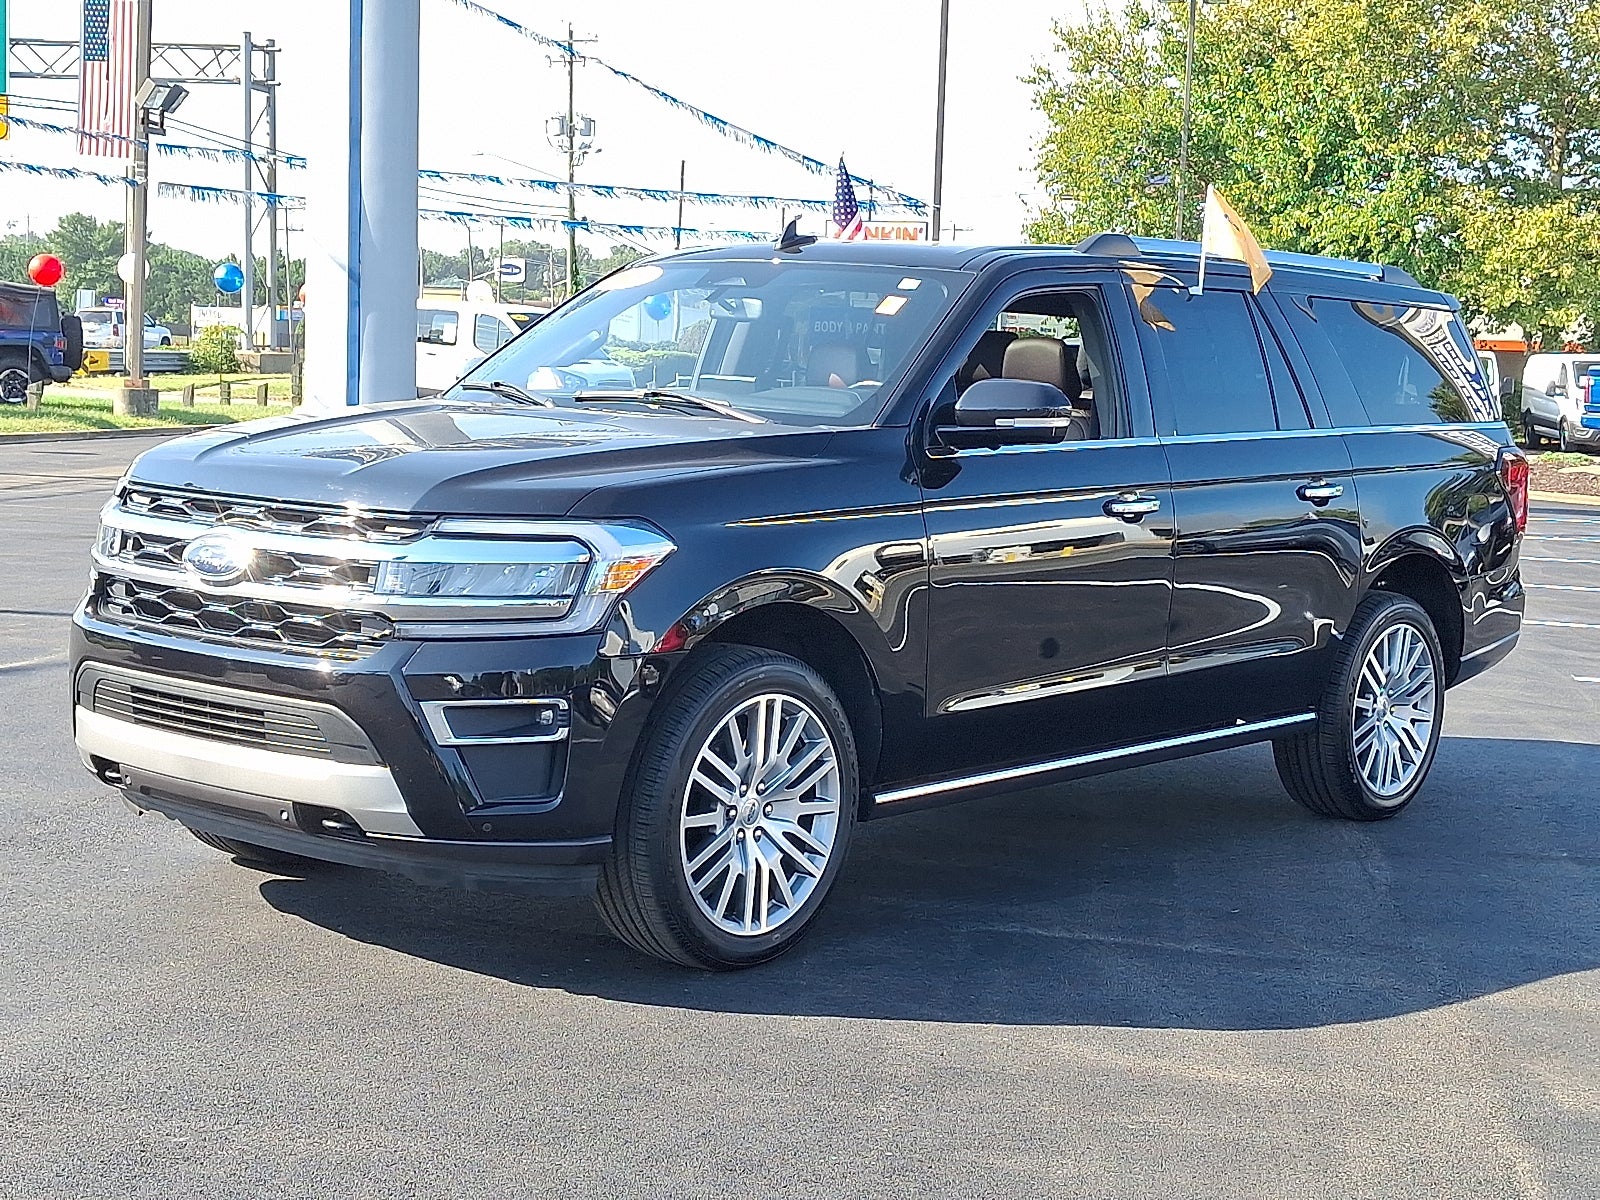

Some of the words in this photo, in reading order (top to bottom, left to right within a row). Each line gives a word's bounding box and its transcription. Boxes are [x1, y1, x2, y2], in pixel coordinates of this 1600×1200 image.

[864, 226, 924, 241] NKIN'
[814, 321, 844, 333] BODY
[856, 322, 887, 335] PANT
